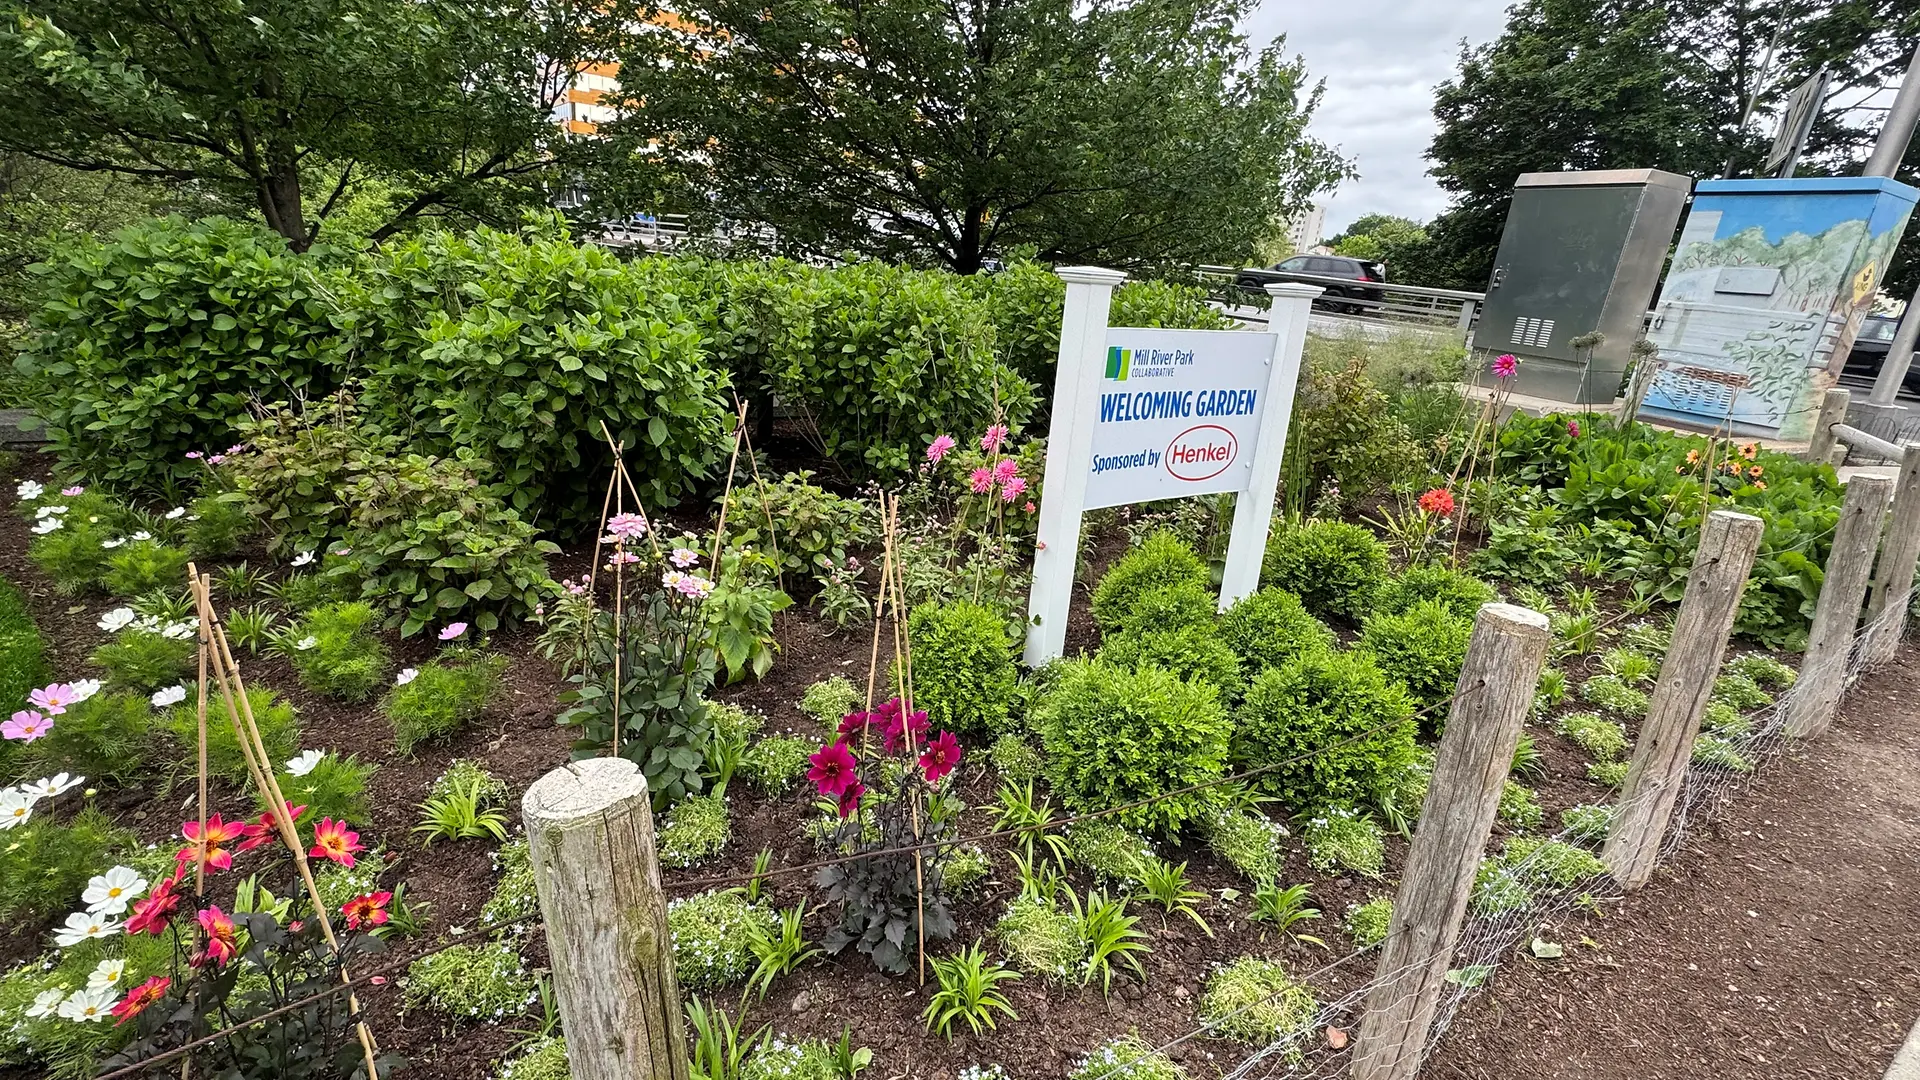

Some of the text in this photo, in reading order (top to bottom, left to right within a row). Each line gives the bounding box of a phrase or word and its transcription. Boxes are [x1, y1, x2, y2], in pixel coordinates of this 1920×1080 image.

[1133, 349, 1195, 366] Mill River Park
[1131, 367, 1174, 378] COLLABORATIVE
[1101, 389, 1257, 423] WELCOMING GARDEN
[1092, 441, 1232, 474] Sponsored by Henkel
